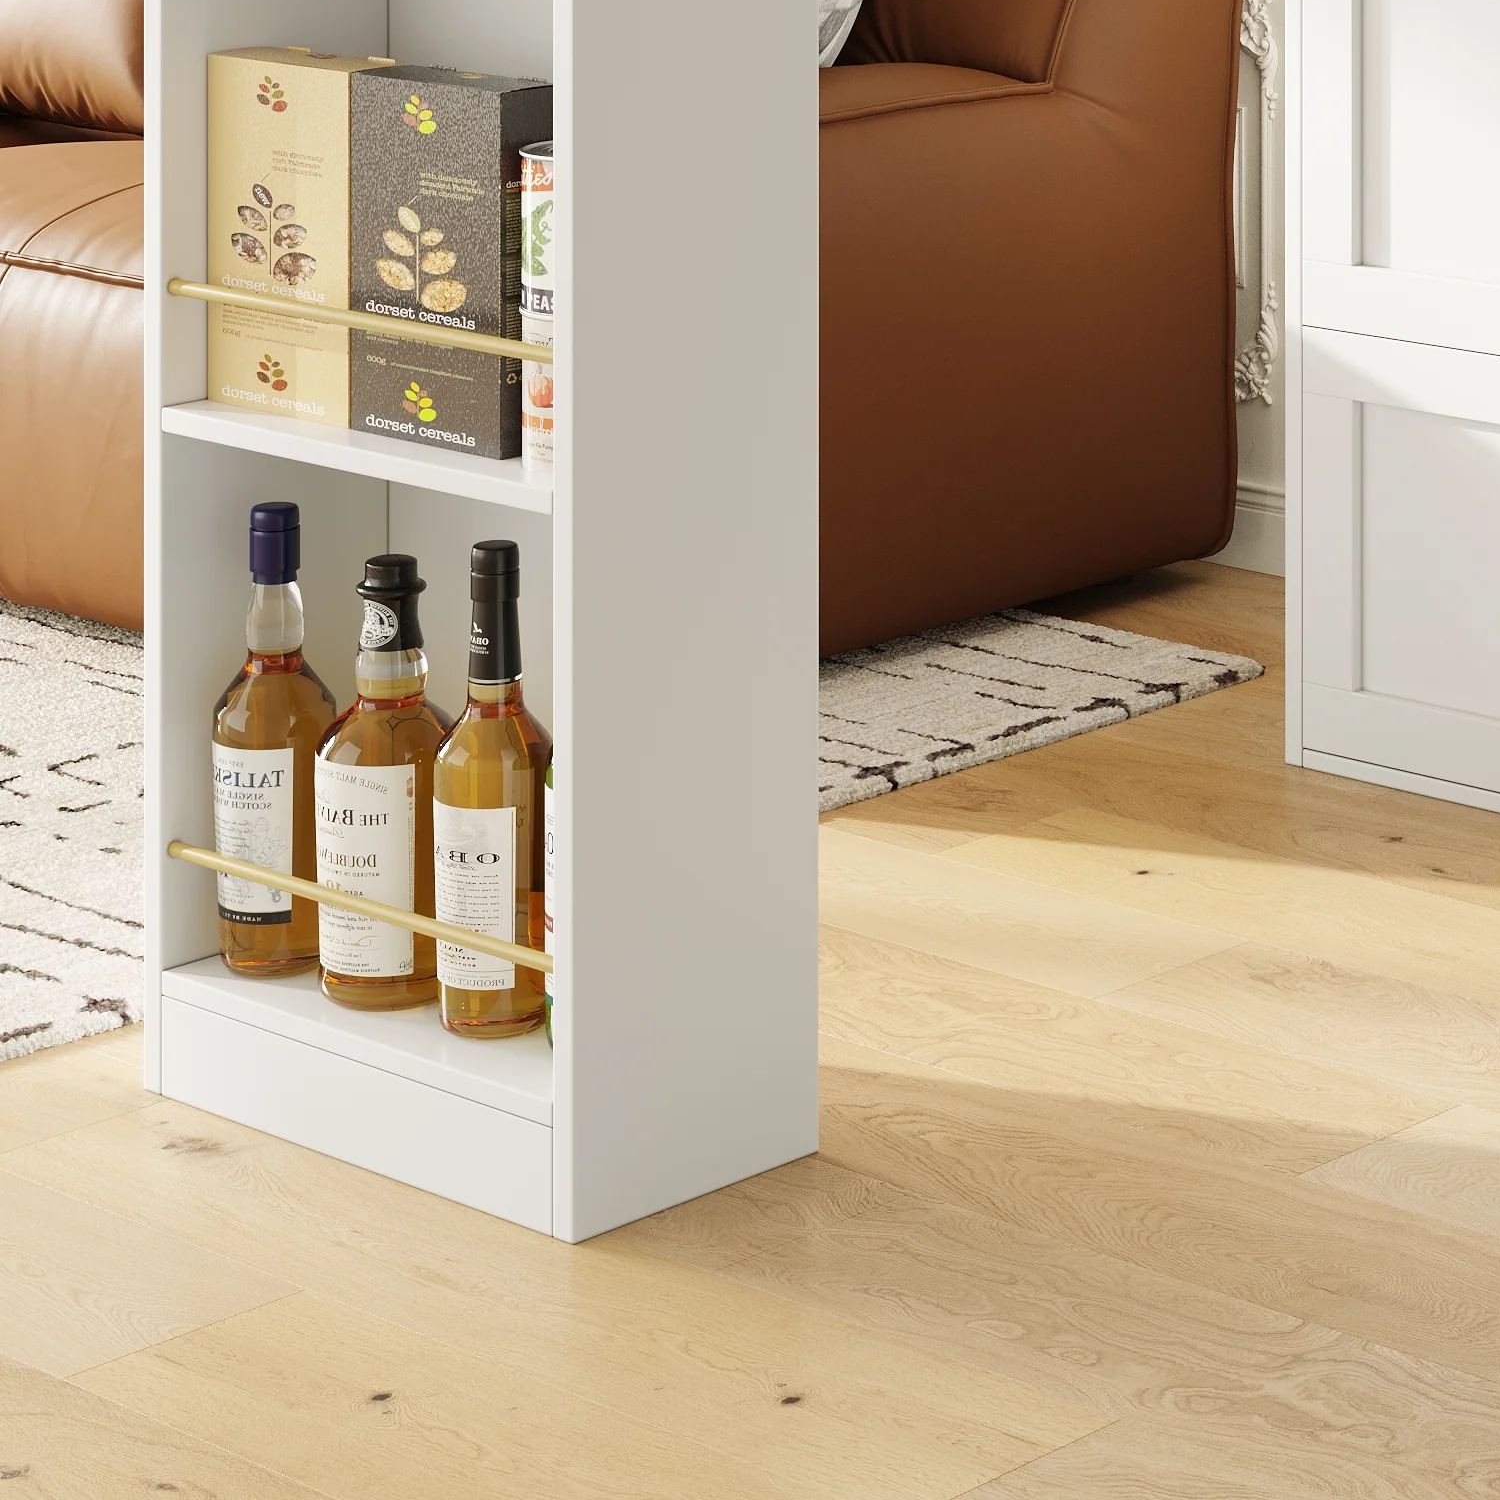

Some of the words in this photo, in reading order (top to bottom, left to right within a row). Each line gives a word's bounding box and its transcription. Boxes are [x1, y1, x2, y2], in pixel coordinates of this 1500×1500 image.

[272, 165, 289, 173] dark
[289, 167, 323, 178] chocolate
[254, 186, 271, 206] new
[221, 274, 269, 293] dorset
[271, 284, 325, 303] cereals
[365, 299, 416, 320] dorset
[418, 311, 476, 331] cereals
[222, 327, 241, 338] 600g
[366, 354, 387, 366] 600g
[221, 385, 269, 405] dorset
[271, 396, 325, 416] cereals
[365, 414, 416, 435] dorset
[418, 426, 476, 447] cereals
